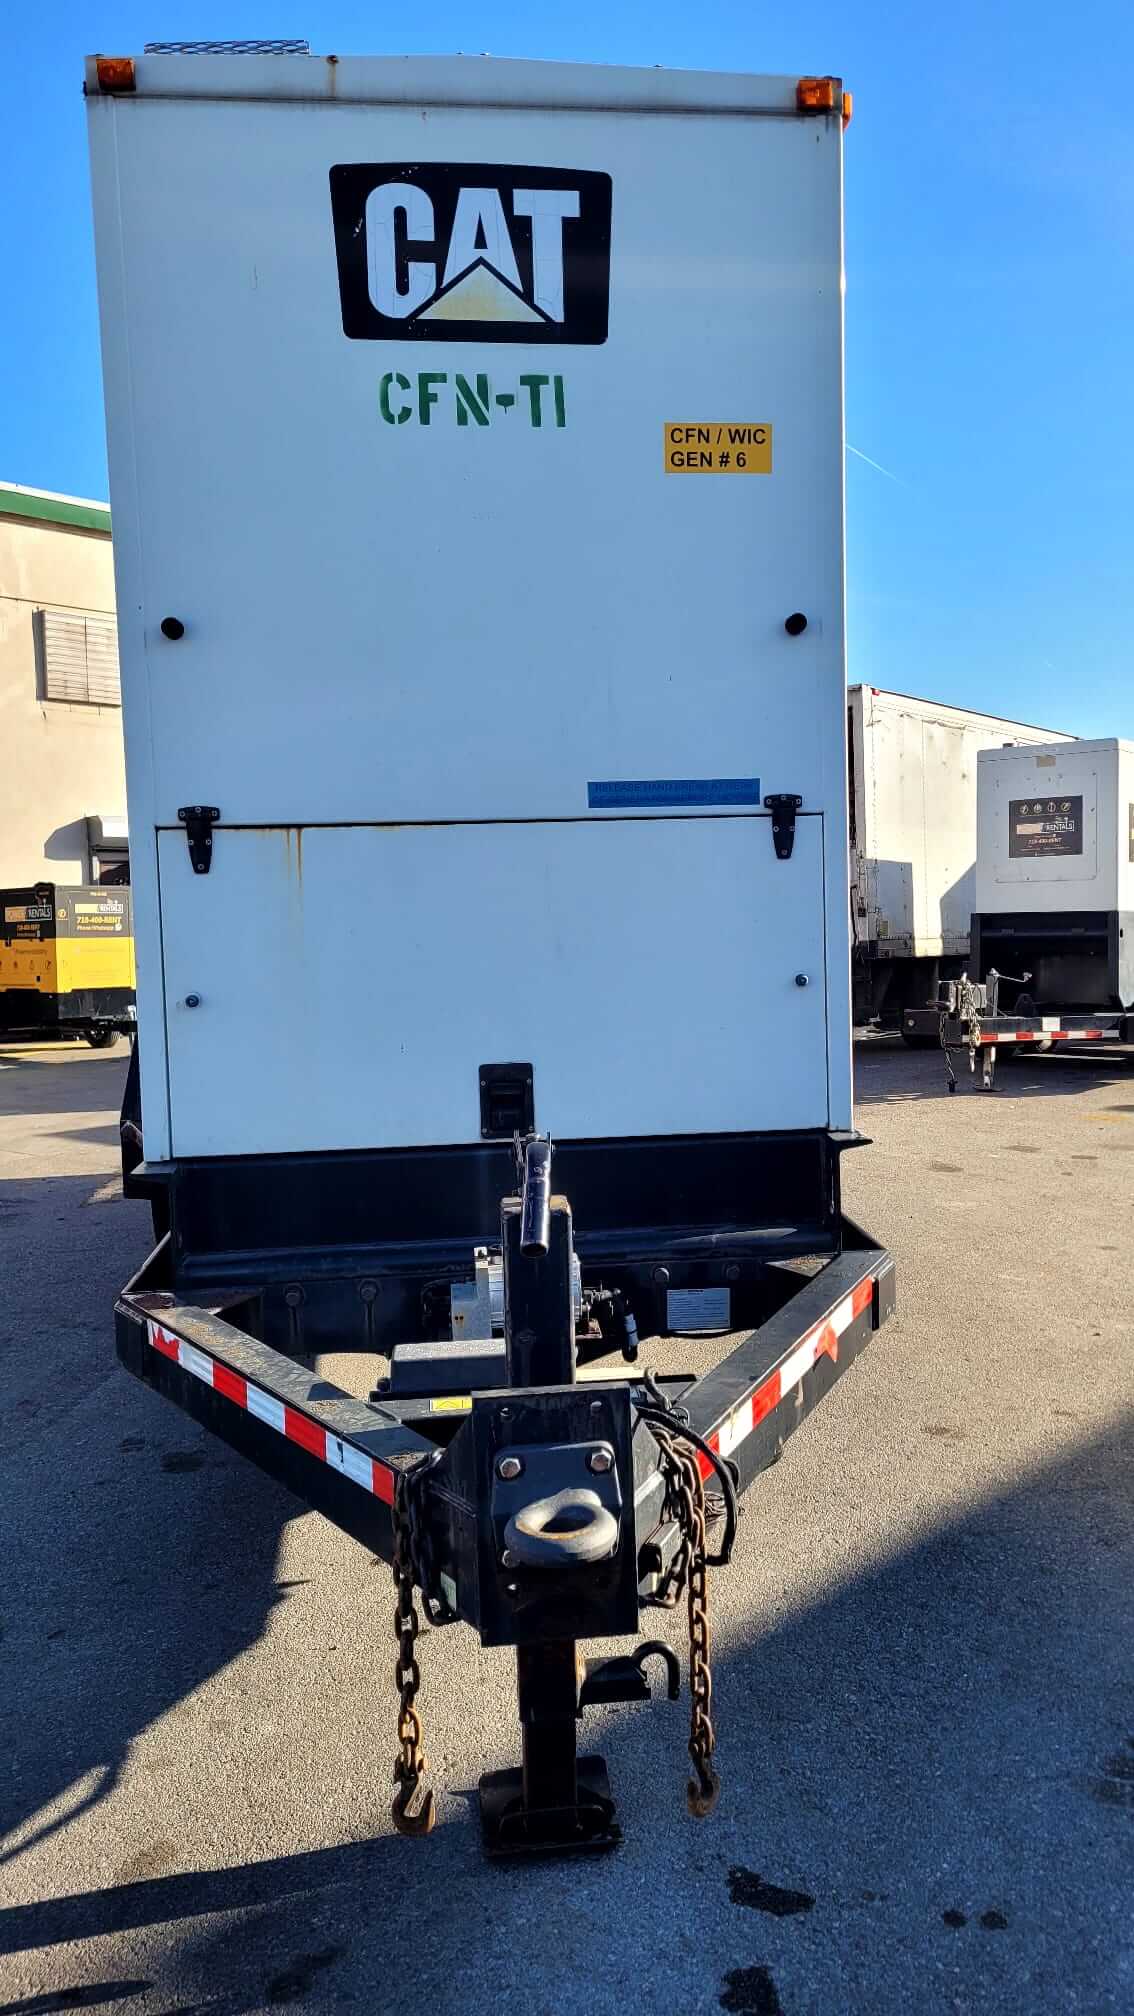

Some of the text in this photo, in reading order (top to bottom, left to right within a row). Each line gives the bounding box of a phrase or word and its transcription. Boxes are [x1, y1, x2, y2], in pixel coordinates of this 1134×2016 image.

[365, 182, 581, 323] CAT
[670, 428, 766, 444] CFN / WIC
[670, 451, 747, 467] GEN # 6
